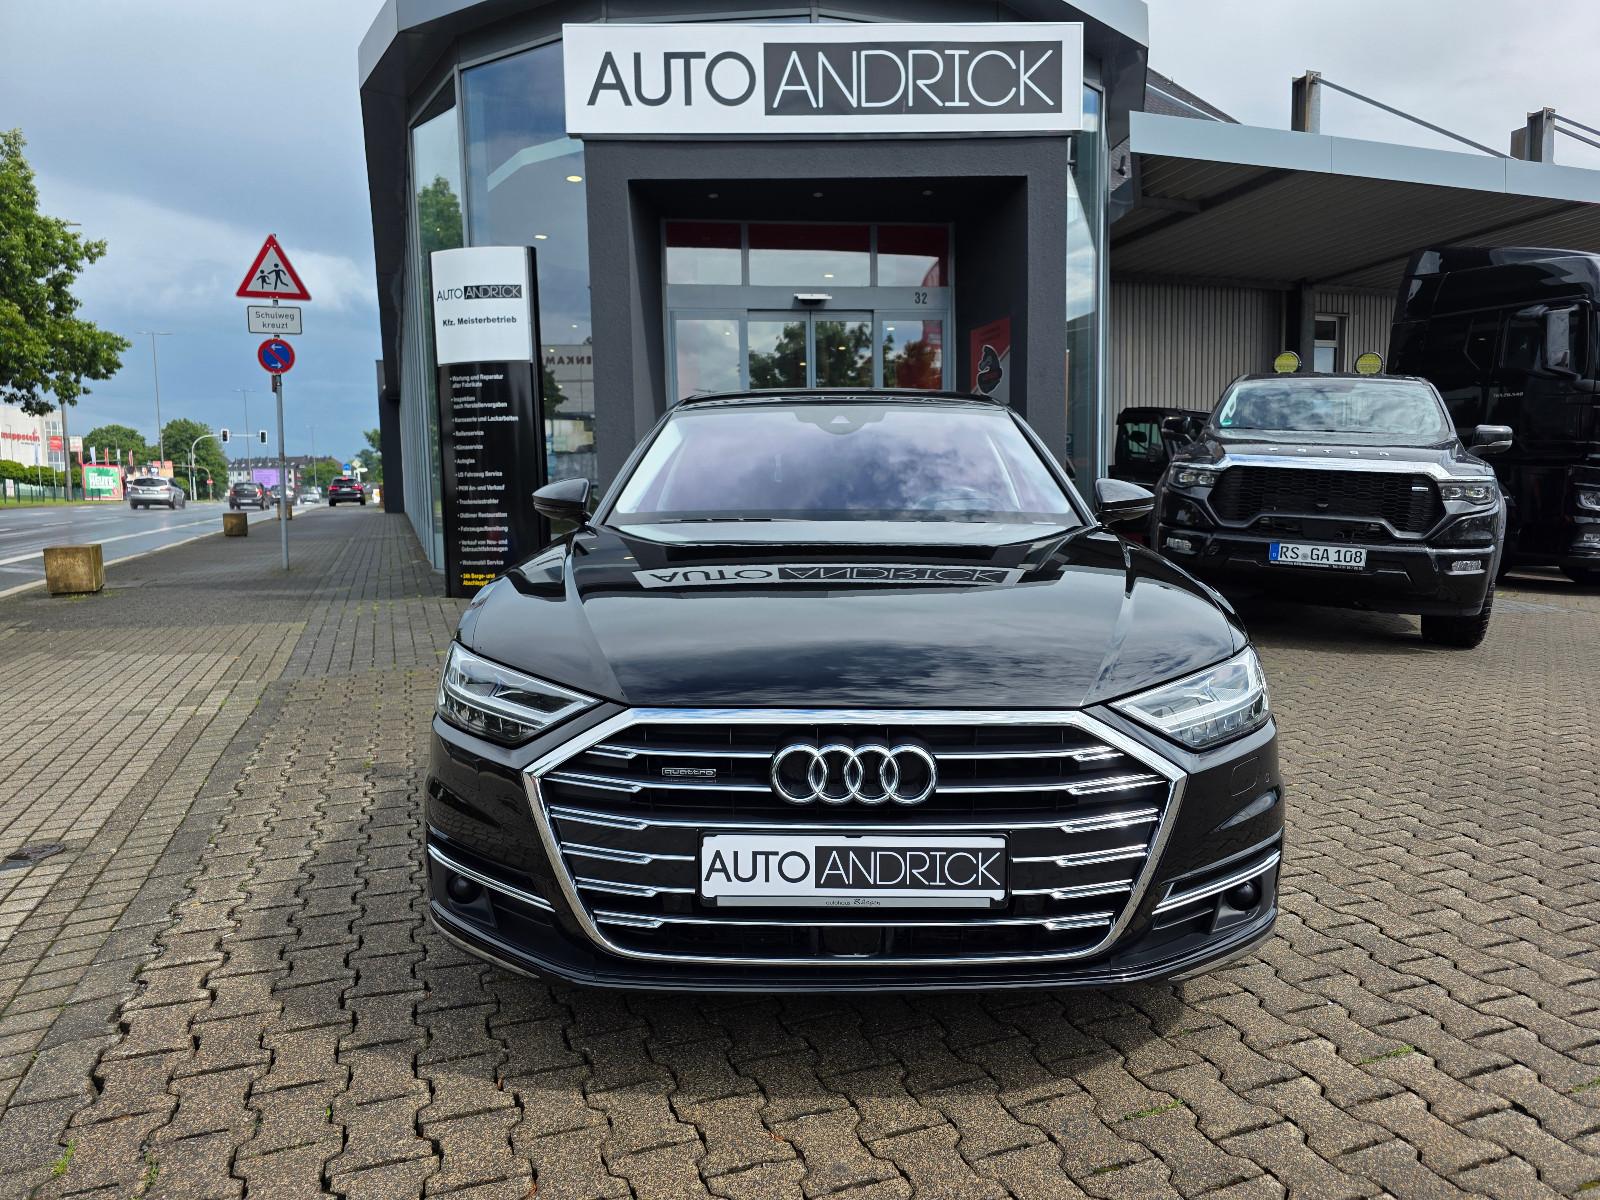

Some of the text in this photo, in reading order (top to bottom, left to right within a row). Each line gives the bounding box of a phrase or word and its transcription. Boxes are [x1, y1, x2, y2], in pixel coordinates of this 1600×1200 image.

[587, 49, 1055, 109] AUTO ANDRICK
[437, 285, 521, 302] AUTO ANDRICK
[914, 291, 928, 305] 32
[255, 311, 295, 321] Schulweg
[442, 315, 517, 327] Kfz. Meisterbetrieb
[262, 321, 289, 329] kreuzt
[480, 373, 503, 381] Reparatur
[1279, 545, 1363, 564] RS GA 108
[703, 849, 1001, 886] AUTO ANDRICK
